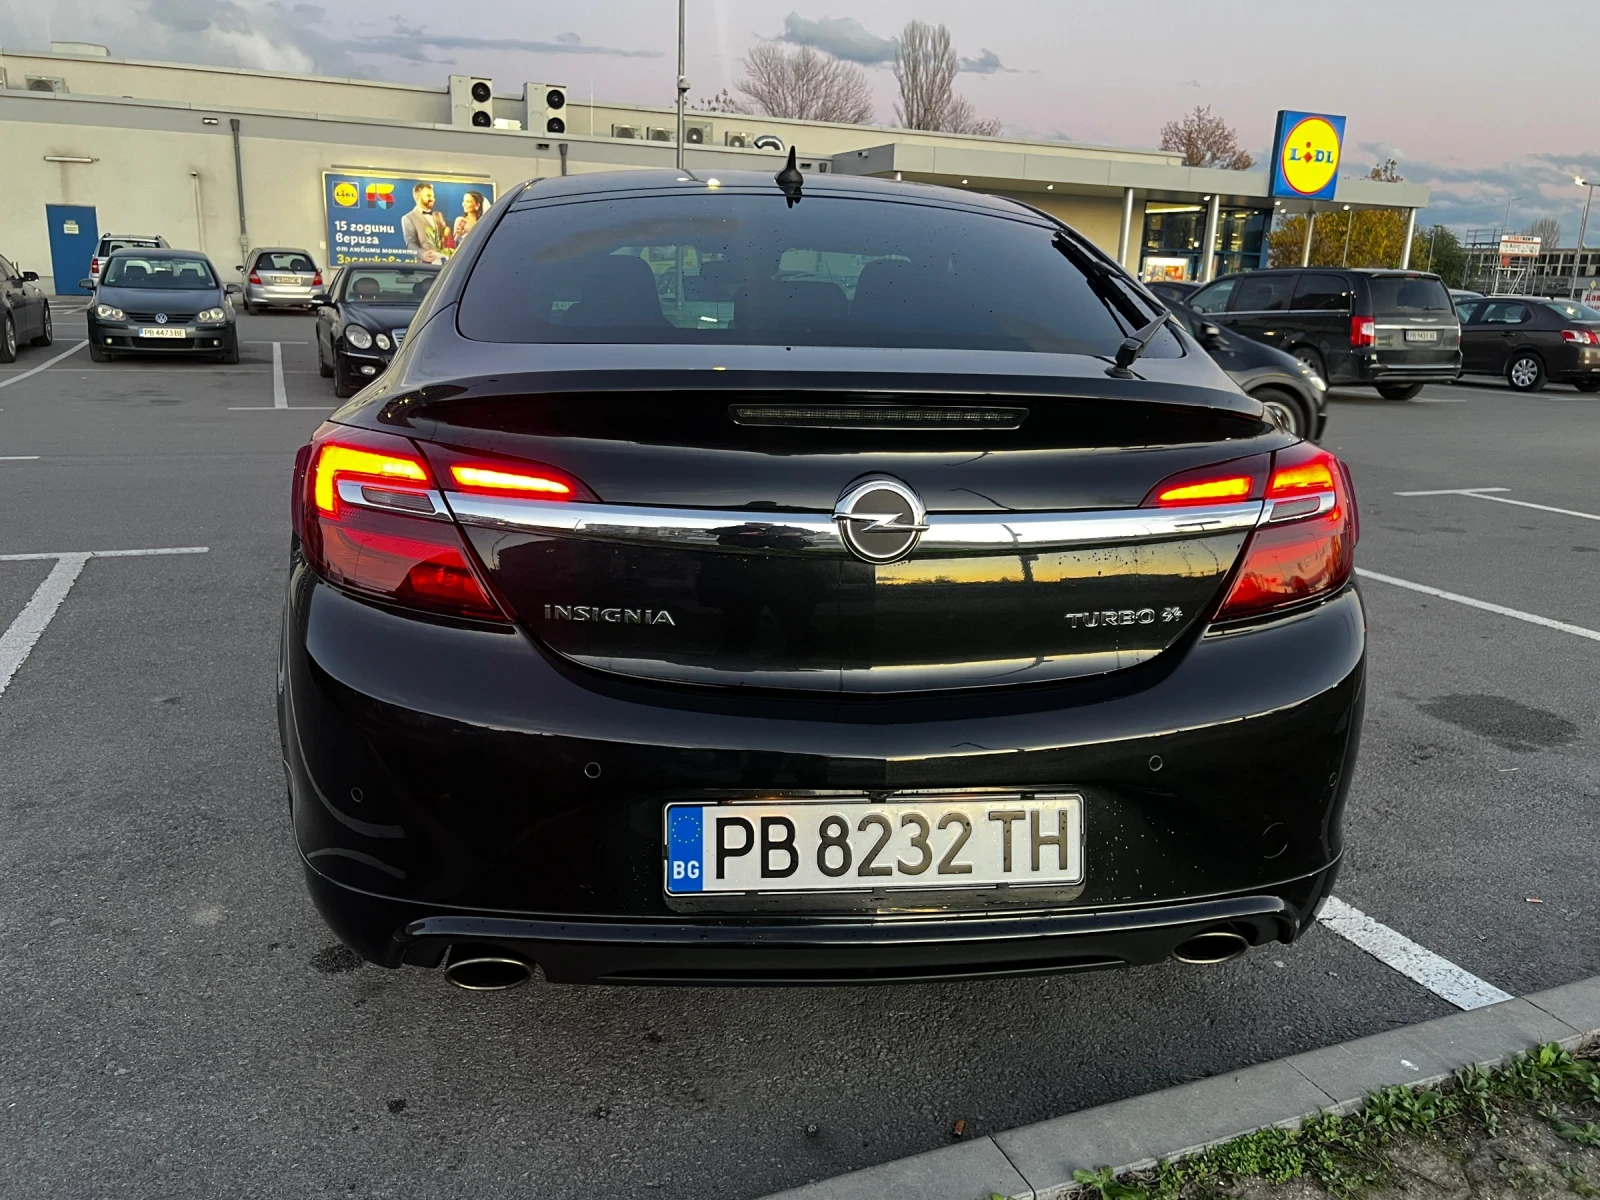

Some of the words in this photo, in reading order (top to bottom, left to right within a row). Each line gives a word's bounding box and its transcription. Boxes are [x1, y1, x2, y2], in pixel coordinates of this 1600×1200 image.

[1288, 141, 1334, 164] LIDL
[334, 220, 348, 231] 15
[350, 223, 395, 235] години
[335, 232, 379, 246] верига
[155, 329, 174, 337] 4473
[544, 604, 676, 626] INSIGNIA
[1065, 608, 1156, 628] TURBO
[715, 816, 800, 880] PB
[816, 811, 974, 878] 8232
[988, 810, 1068, 873] TH
[673, 861, 699, 879] BG
